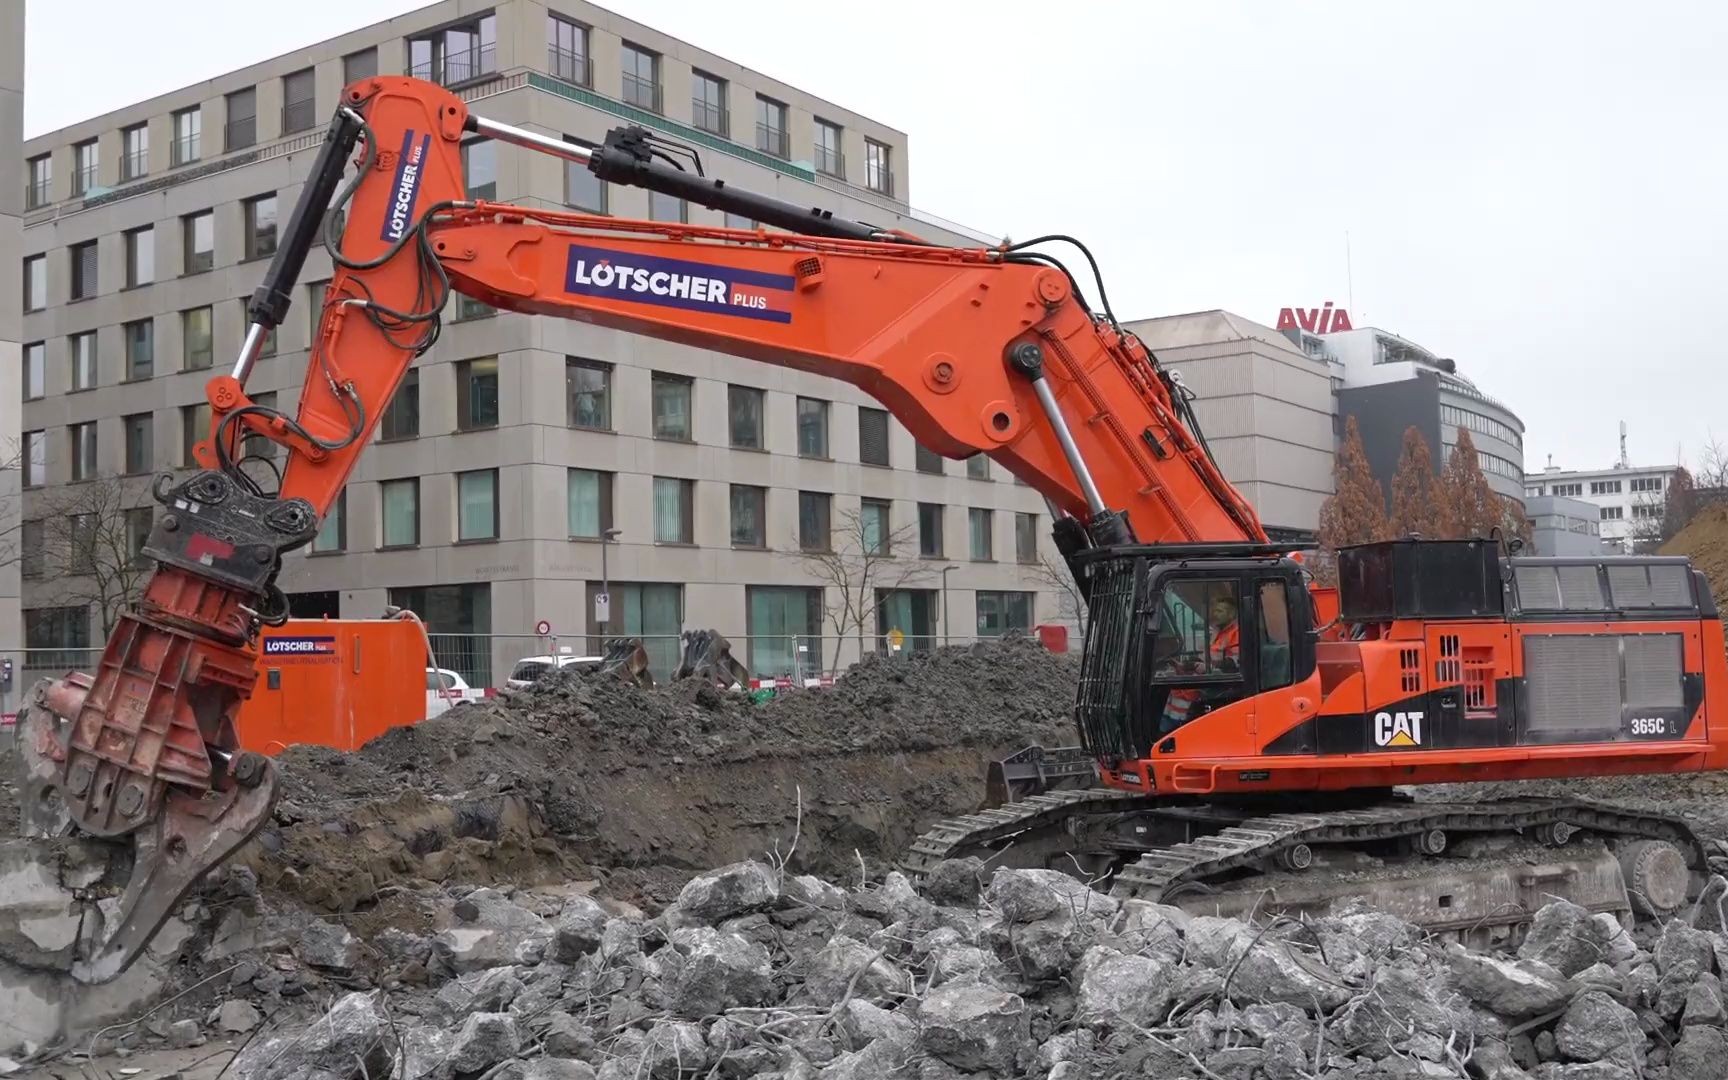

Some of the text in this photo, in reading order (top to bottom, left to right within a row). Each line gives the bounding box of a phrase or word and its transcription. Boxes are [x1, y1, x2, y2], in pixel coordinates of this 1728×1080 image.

[733, 293, 767, 309] PLUS
[1375, 712, 1424, 746] CAT
[1631, 717, 1665, 735] 365C
